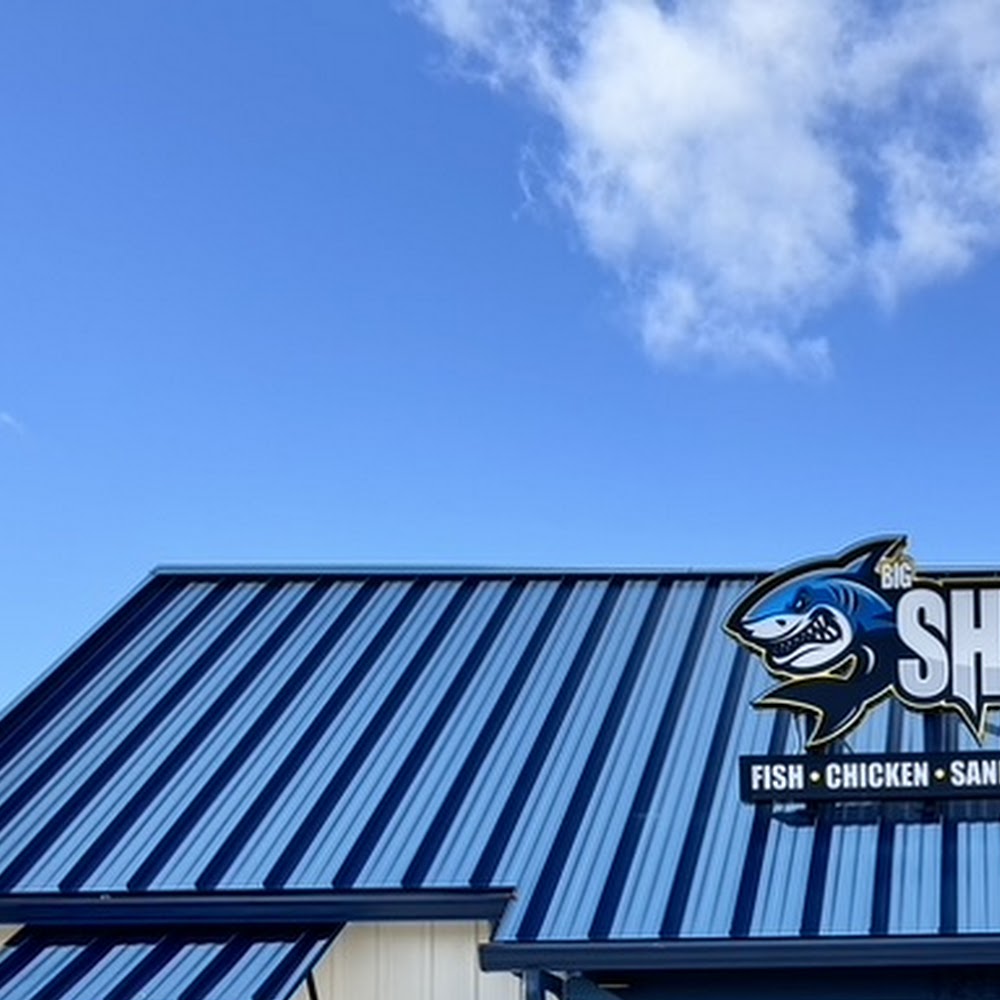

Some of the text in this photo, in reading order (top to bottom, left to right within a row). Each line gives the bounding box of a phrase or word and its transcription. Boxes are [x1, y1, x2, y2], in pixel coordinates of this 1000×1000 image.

[881, 561, 912, 589] BIG
[751, 764, 804, 790] FISH
[826, 761, 929, 789] CHICKEN
